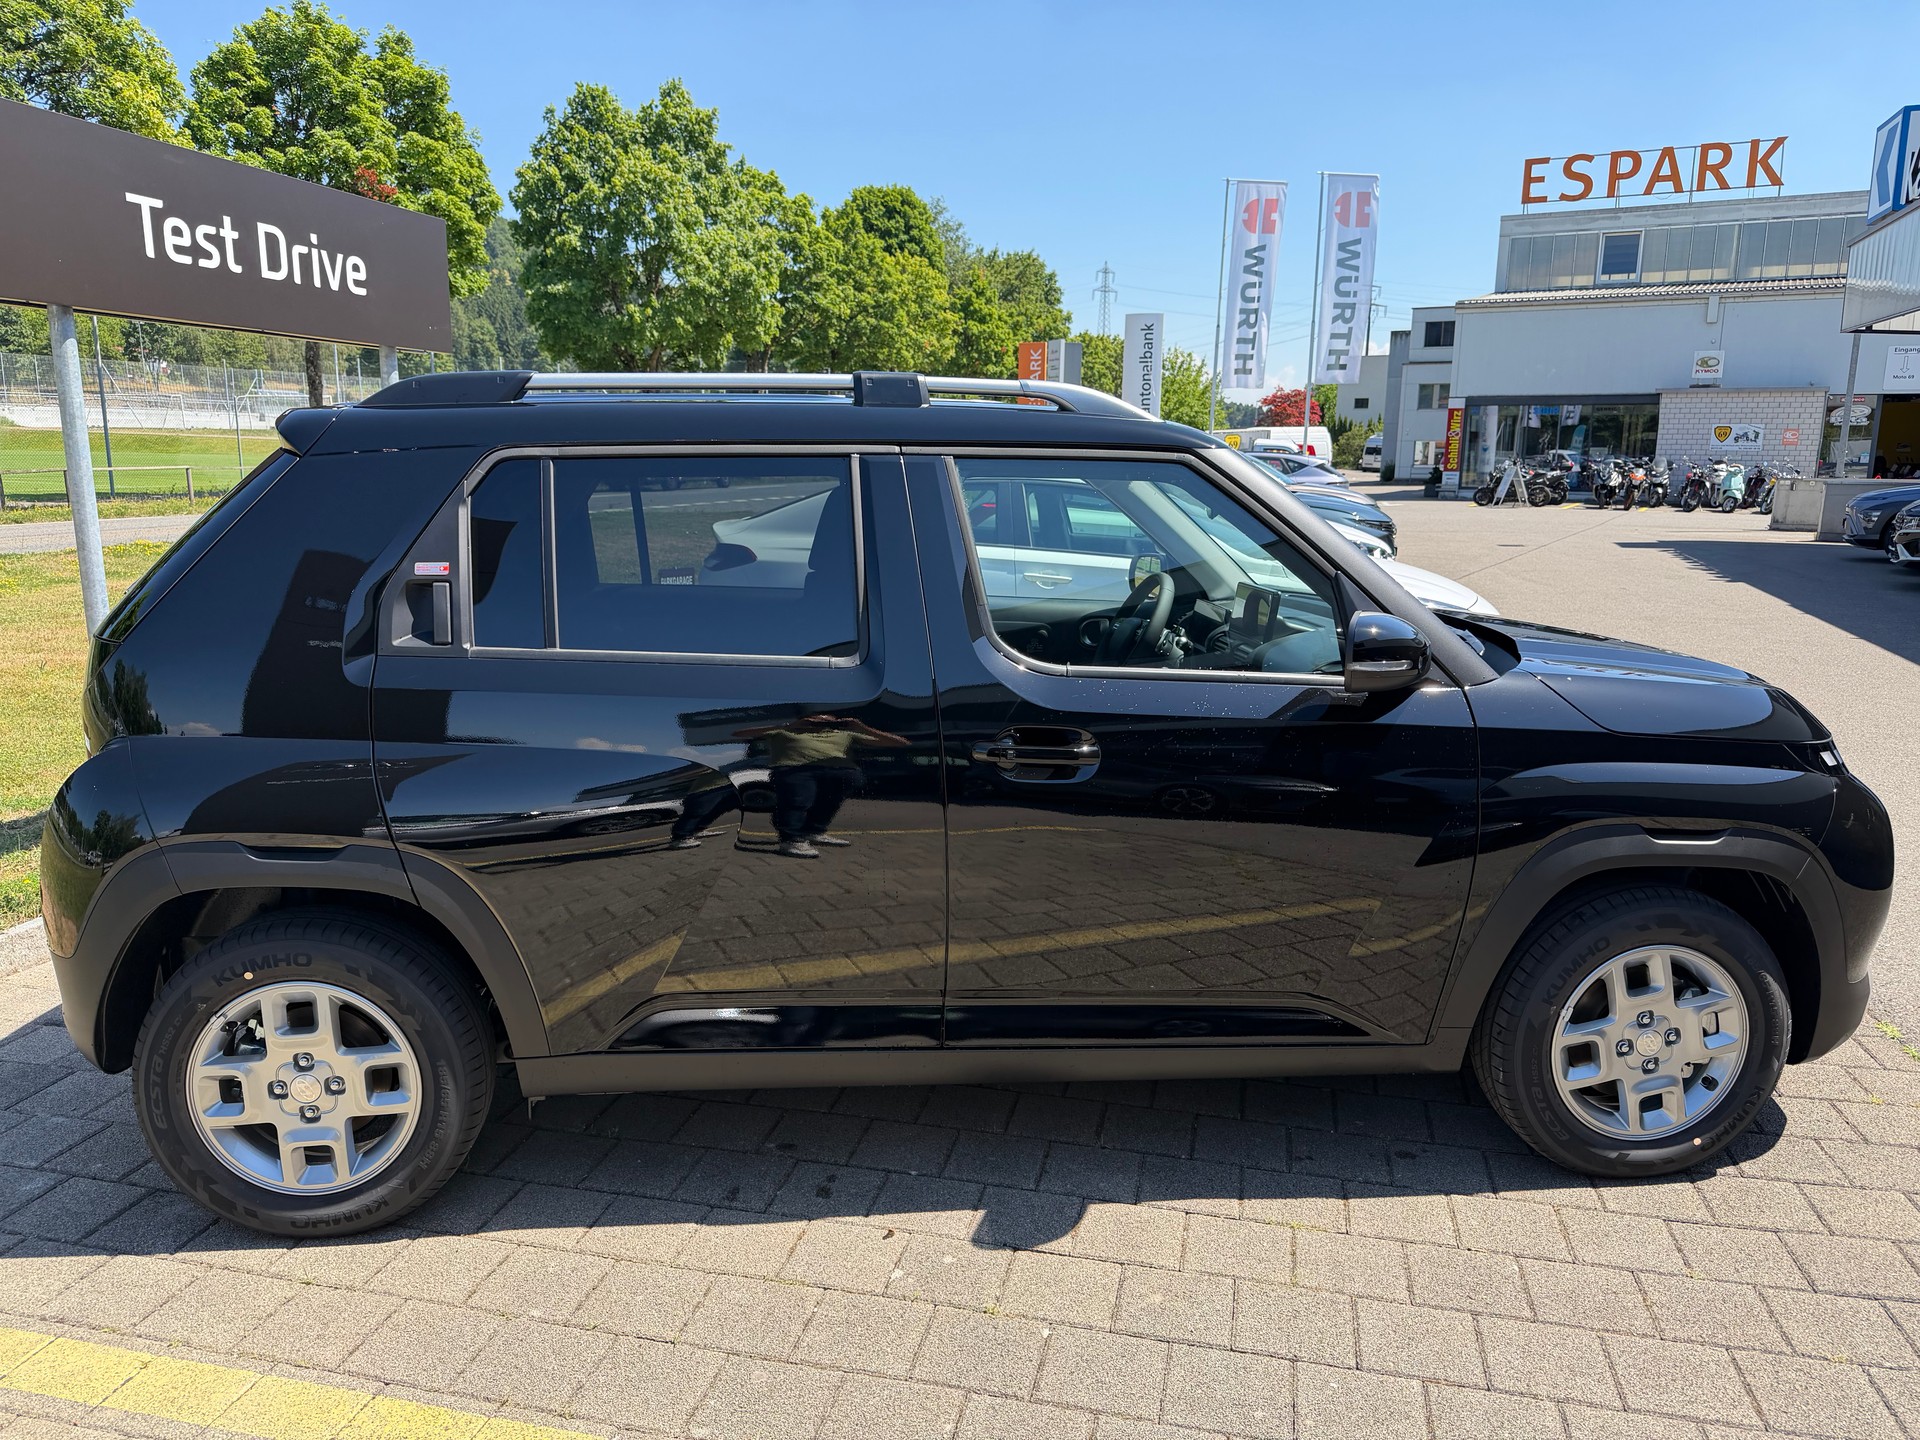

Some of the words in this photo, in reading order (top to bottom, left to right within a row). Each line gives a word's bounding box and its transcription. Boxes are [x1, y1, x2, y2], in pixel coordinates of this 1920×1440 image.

[1521, 136, 1789, 205] ESPARK
[125, 192, 242, 274] Test
[257, 221, 367, 296] Drive
[1233, 243, 1267, 376] WÜRTH
[1326, 237, 1362, 371] WÜRTH
[1717, 430, 1728, 439] 69
[211, 952, 313, 988] KUMHO
[1543, 935, 1611, 1006] KUMHO
[1700, 1086, 1765, 1153] KUMHO
[290, 1194, 389, 1229] KUMHO
